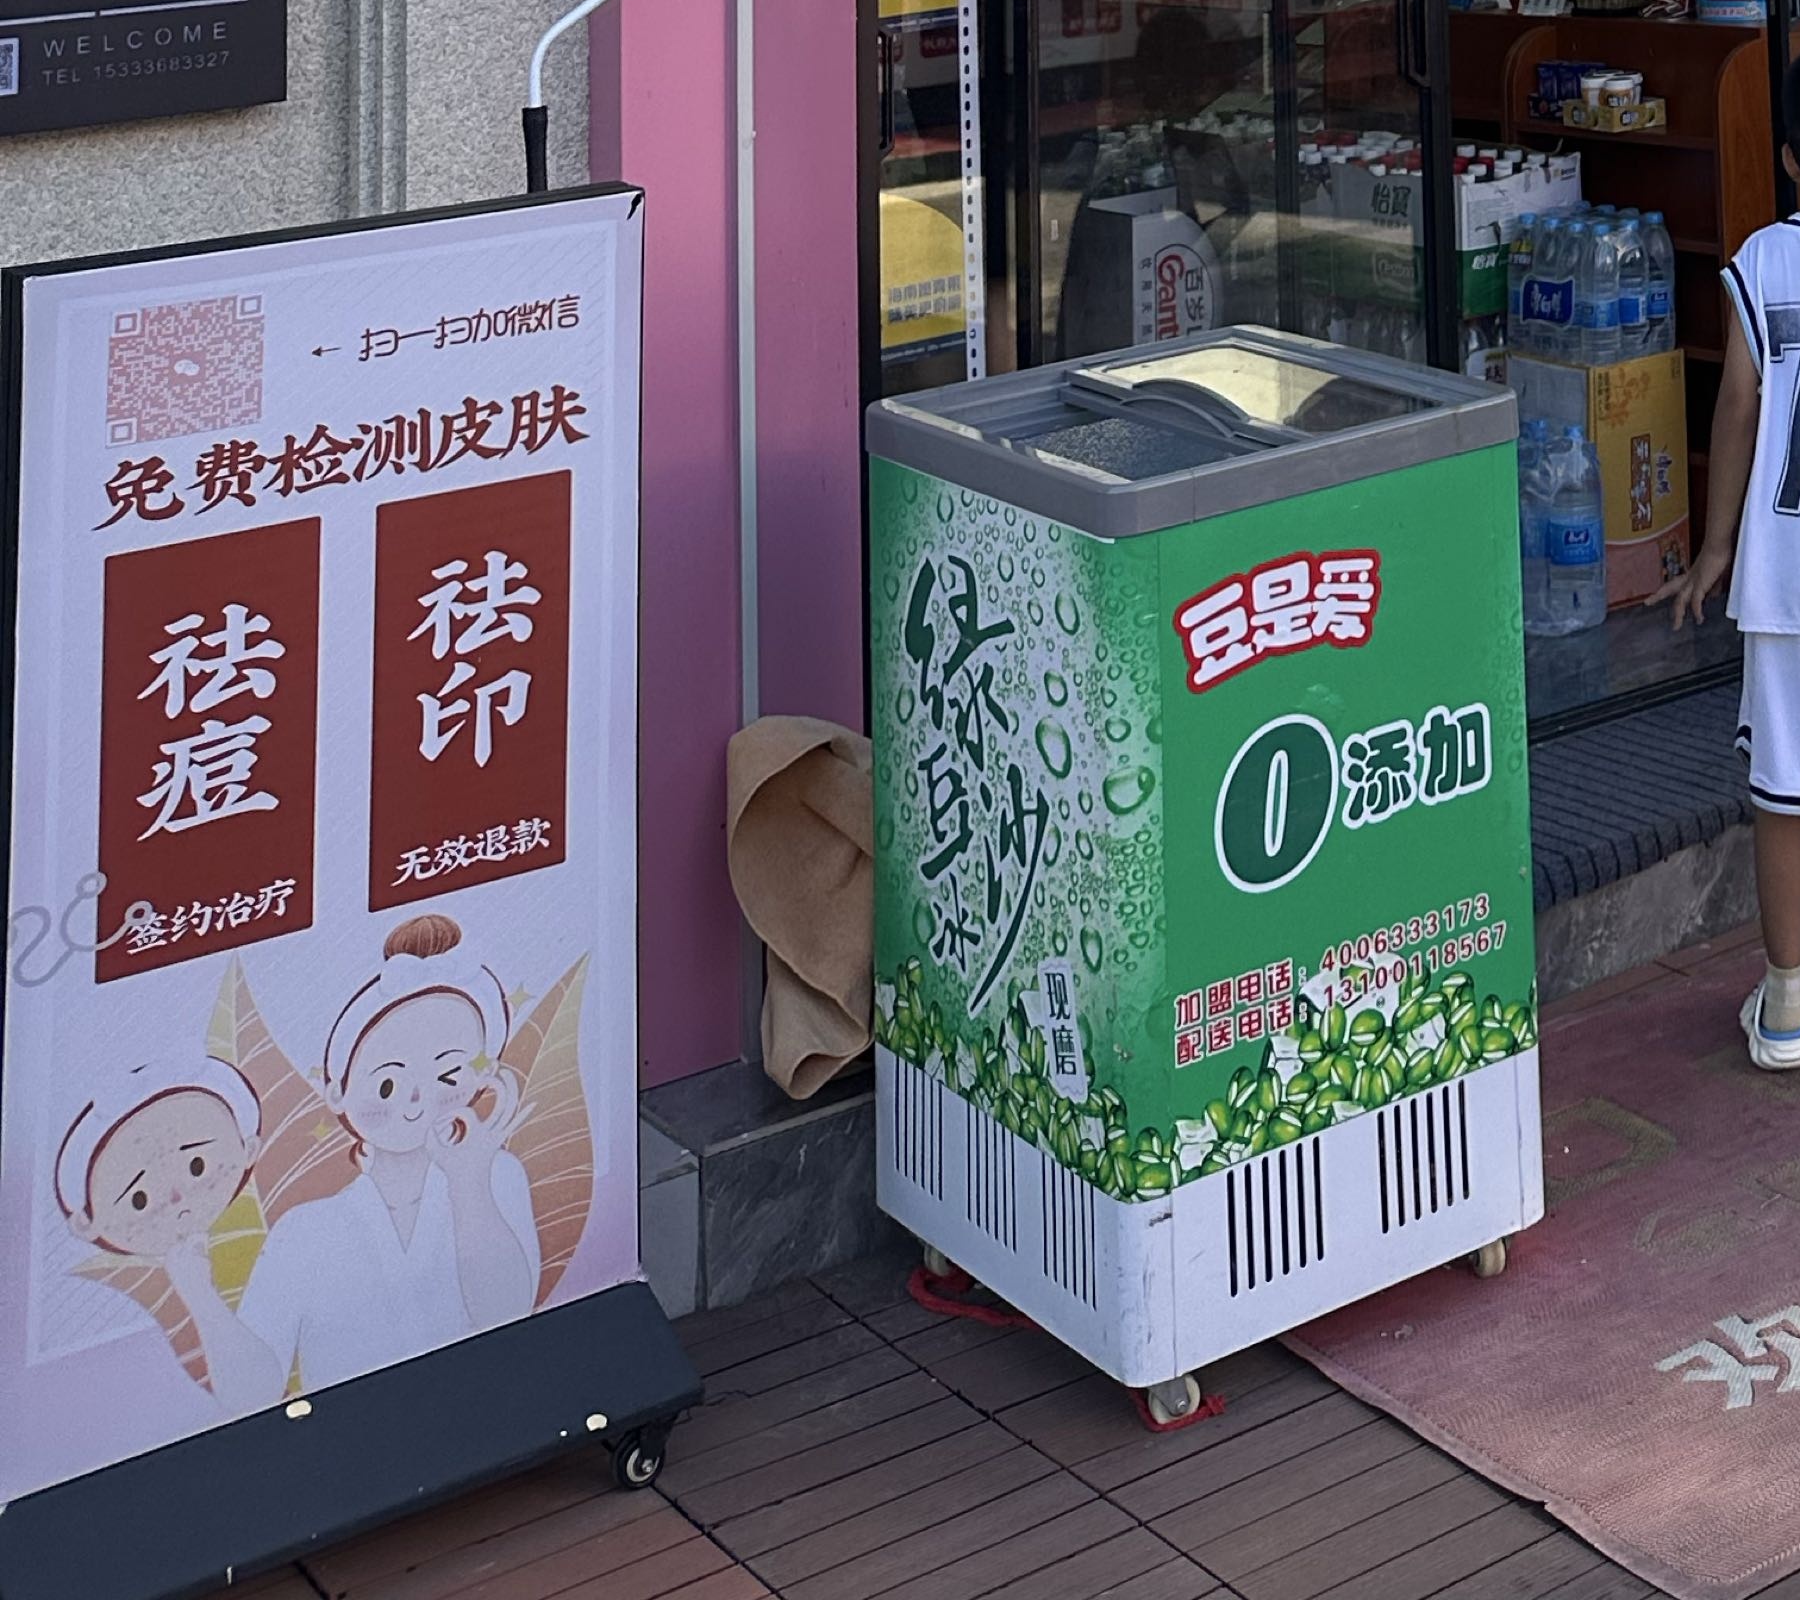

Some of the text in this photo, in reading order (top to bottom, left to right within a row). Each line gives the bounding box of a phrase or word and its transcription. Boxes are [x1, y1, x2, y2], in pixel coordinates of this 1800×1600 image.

[42, 69, 81, 86] TEL
[43, 21, 227, 58] WELCOME
[359, 294, 582, 361] 扫一扫加微信
[1158, 253, 1184, 340] Gant
[92, 384, 591, 532] 免费检测皮肤
[406, 550, 543, 769] 祛印
[1180, 557, 1375, 688] 豆是爱
[137, 602, 286, 842] 祛痘
[395, 818, 551, 887] 无效退款
[125, 879, 297, 956] 签约治疗
[1044, 968, 1077, 1079] 现磨
